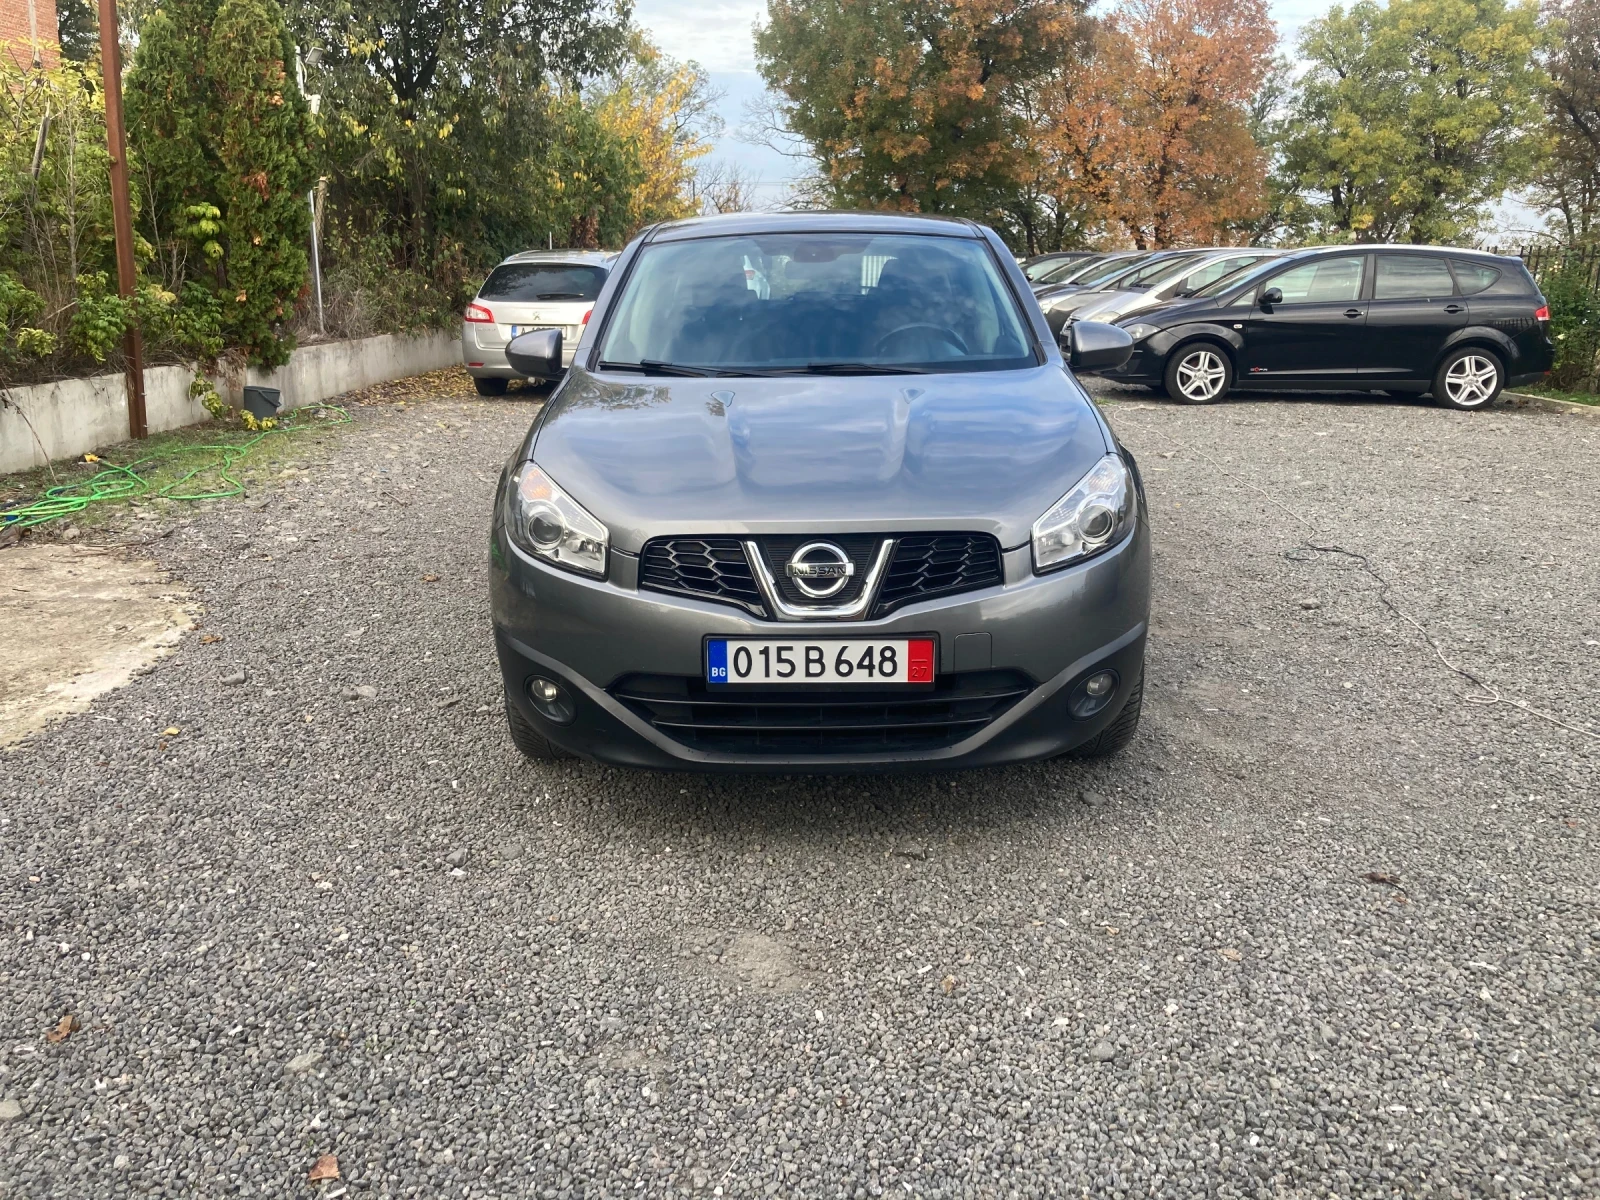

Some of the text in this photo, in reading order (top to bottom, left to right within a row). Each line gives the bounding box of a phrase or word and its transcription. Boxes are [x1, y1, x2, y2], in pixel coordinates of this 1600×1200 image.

[793, 565, 847, 575] NISSAN
[711, 667, 726, 677] BG
[911, 666, 928, 678] 27
